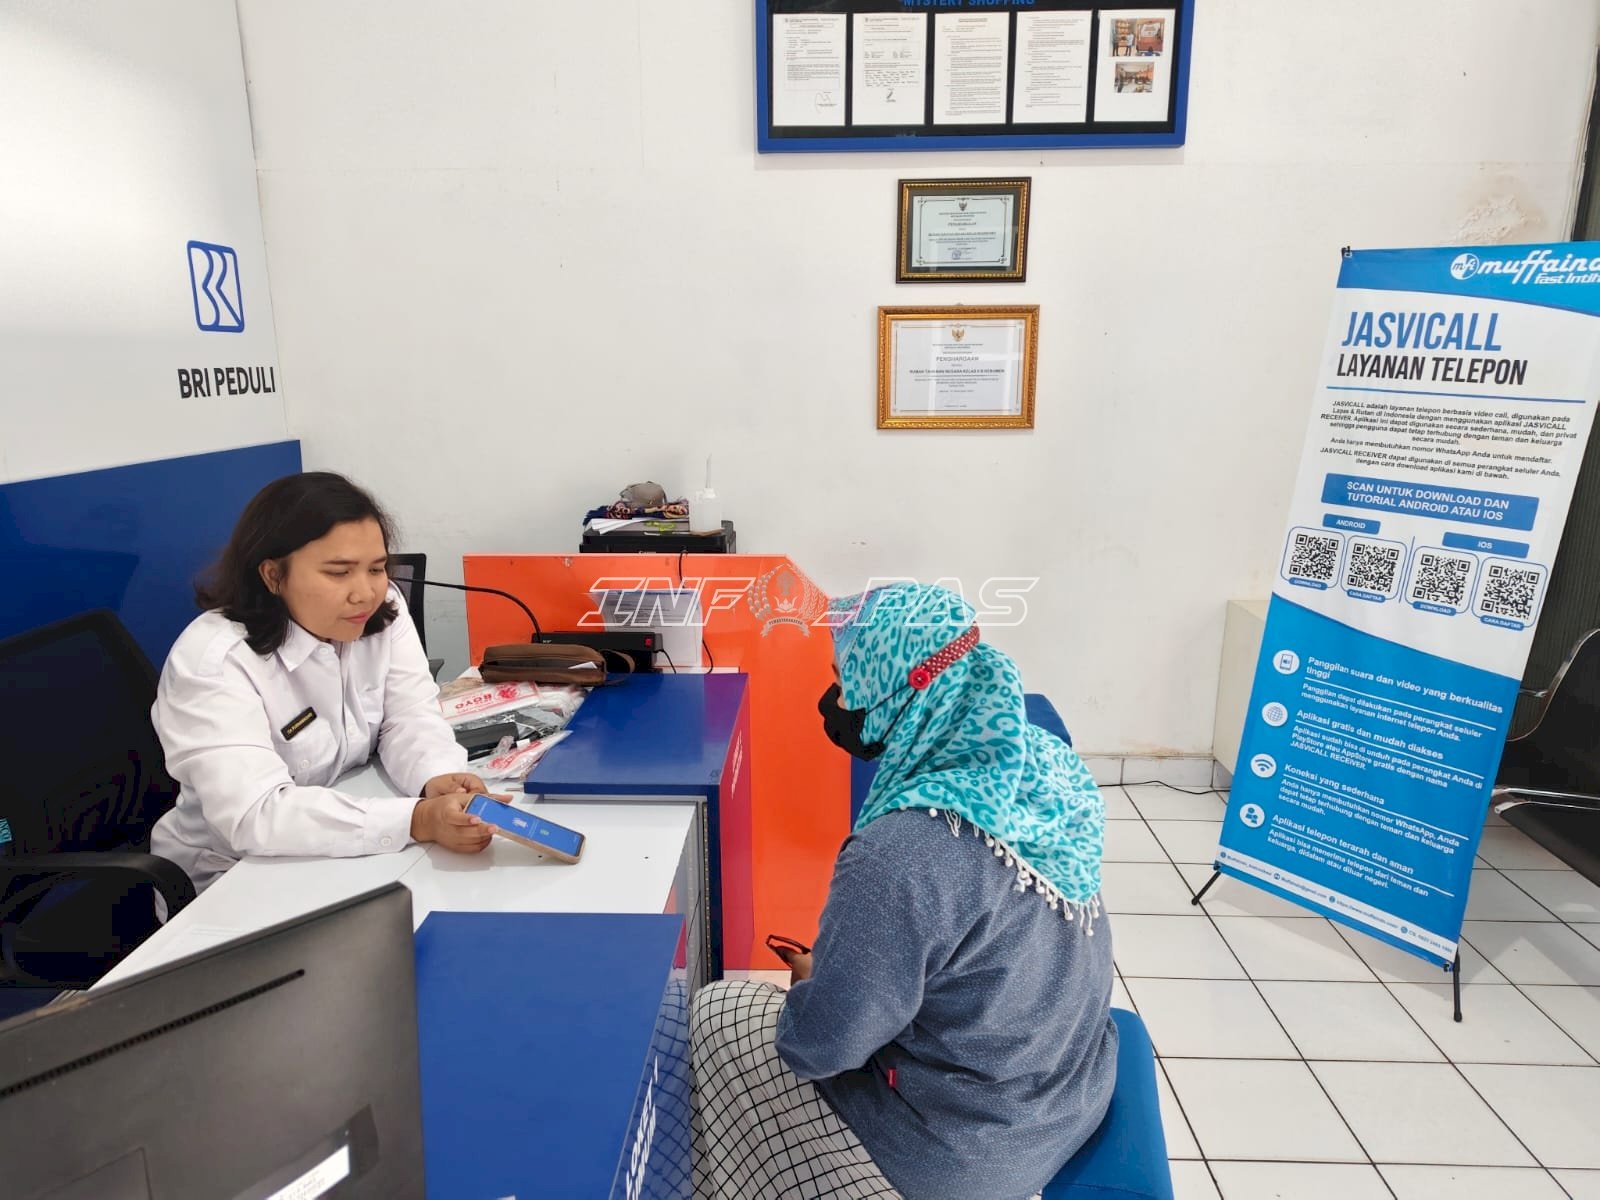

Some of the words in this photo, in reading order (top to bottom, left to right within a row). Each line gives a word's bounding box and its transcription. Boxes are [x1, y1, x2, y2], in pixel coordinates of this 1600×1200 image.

[1341, 311, 1502, 351] JASVICALL
[178, 367, 211, 399] BRI
[214, 366, 276, 396] PEDULI
[1337, 353, 1426, 381] LAYANAN
[1432, 357, 1528, 386] TELEPON
[1409, 420, 1445, 428] digunakan
[1426, 429, 1462, 438] terhubung
[1463, 432, 1490, 440] dengan
[1530, 438, 1563, 446] keluarga
[1319, 447, 1353, 455] JASVICALL
[1408, 456, 1443, 464] digunakan
[1364, 442, 1411, 450] membutuhkan
[1435, 447, 1471, 457] WhatsApp
[1396, 462, 1429, 470] download
[1483, 471, 1509, 479] bawah.
[1346, 481, 1374, 492] SCAN
[1375, 485, 1413, 497] UNTUK
[1415, 490, 1481, 505] DOWNLOAD
[1483, 498, 1509, 509] DAN
[1346, 492, 1395, 506] TUTORIAL
[1398, 498, 1449, 513] ANDROID
[1450, 505, 1480, 517] ATAU
[1483, 509, 1504, 520] IOS
[1336, 519, 1366, 528] ANDROID
[1477, 541, 1493, 550] IOS
[1306, 667, 1331, 679] tinggi
[1309, 656, 1349, 673] Panggilan
[1351, 669, 1374, 680] suara
[1376, 674, 1393, 685] dan
[1396, 680, 1421, 692] video
[1423, 687, 1446, 700] yang
[1450, 692, 1503, 713] berkualitas
[1301, 692, 1348, 709] menggunakan
[1350, 705, 1375, 717] layanan
[1377, 712, 1406, 725] internet
[1408, 721, 1435, 734] telepon
[1437, 729, 1460, 741] Anda.
[1303, 683, 1336, 697] Panggilan
[1357, 698, 1391, 713] dilakukan
[1394, 709, 1412, 718] pada
[1413, 715, 1452, 729] perangkat
[1454, 726, 1482, 737] seluler
[1291, 740, 1328, 757] JASVICALL
[1297, 709, 1330, 725] Aplikasi
[1331, 721, 1354, 732] gratis
[1357, 727, 1371, 737] dan
[1374, 733, 1406, 748] mudah
[1408, 742, 1443, 759] diakses
[1294, 725, 1320, 739] Aplikasi
[1322, 735, 1343, 745] sudah
[1344, 741, 1357, 750] bisa
[1360, 745, 1366, 753] di
[1367, 749, 1390, 760] unduh
[1392, 757, 1410, 766] pada
[1412, 763, 1450, 779] perangkat
[1452, 774, 1473, 786] Anda
[1475, 781, 1482, 789] di
[1326, 744, 1340, 753] atau
[1374, 760, 1394, 770] gratis
[1397, 766, 1424, 780] dengan
[1426, 776, 1447, 787] nama
[1285, 763, 1317, 781] Koneksi
[1319, 777, 1339, 790] yang
[1342, 785, 1384, 804] sederhana
[1279, 795, 1299, 805] secara
[1301, 803, 1325, 814] mudah.
[1282, 779, 1299, 790] Anda
[1301, 785, 1320, 797] hanya
[1322, 794, 1369, 815] membutuhkan
[1371, 811, 1393, 823] nomor
[1438, 833, 1459, 846] Anda
[1318, 799, 1352, 819] terhubung
[1354, 812, 1378, 827] dengan
[1381, 822, 1402, 836] teman
[1405, 830, 1419, 842] dan
[1421, 836, 1454, 855] keluarga
[1273, 814, 1304, 832] Aplikasi
[1307, 827, 1337, 844] telepon
[1339, 839, 1369, 857] terarah
[1372, 852, 1387, 864] dan
[1390, 860, 1413, 874] aman
[1270, 828, 1295, 843] Aplikasi
[1297, 839, 1310, 849] bisa
[1312, 846, 1345, 863] menerima
[1348, 859, 1373, 874] telepon
[1375, 870, 1389, 881] dari
[1390, 876, 1412, 890] teman
[1414, 885, 1428, 896] dan
[1299, 848, 1324, 864] didalam
[1327, 860, 1341, 870] atau
[1343, 865, 1363, 879] diluar
[1365, 875, 1388, 889] negeri.
